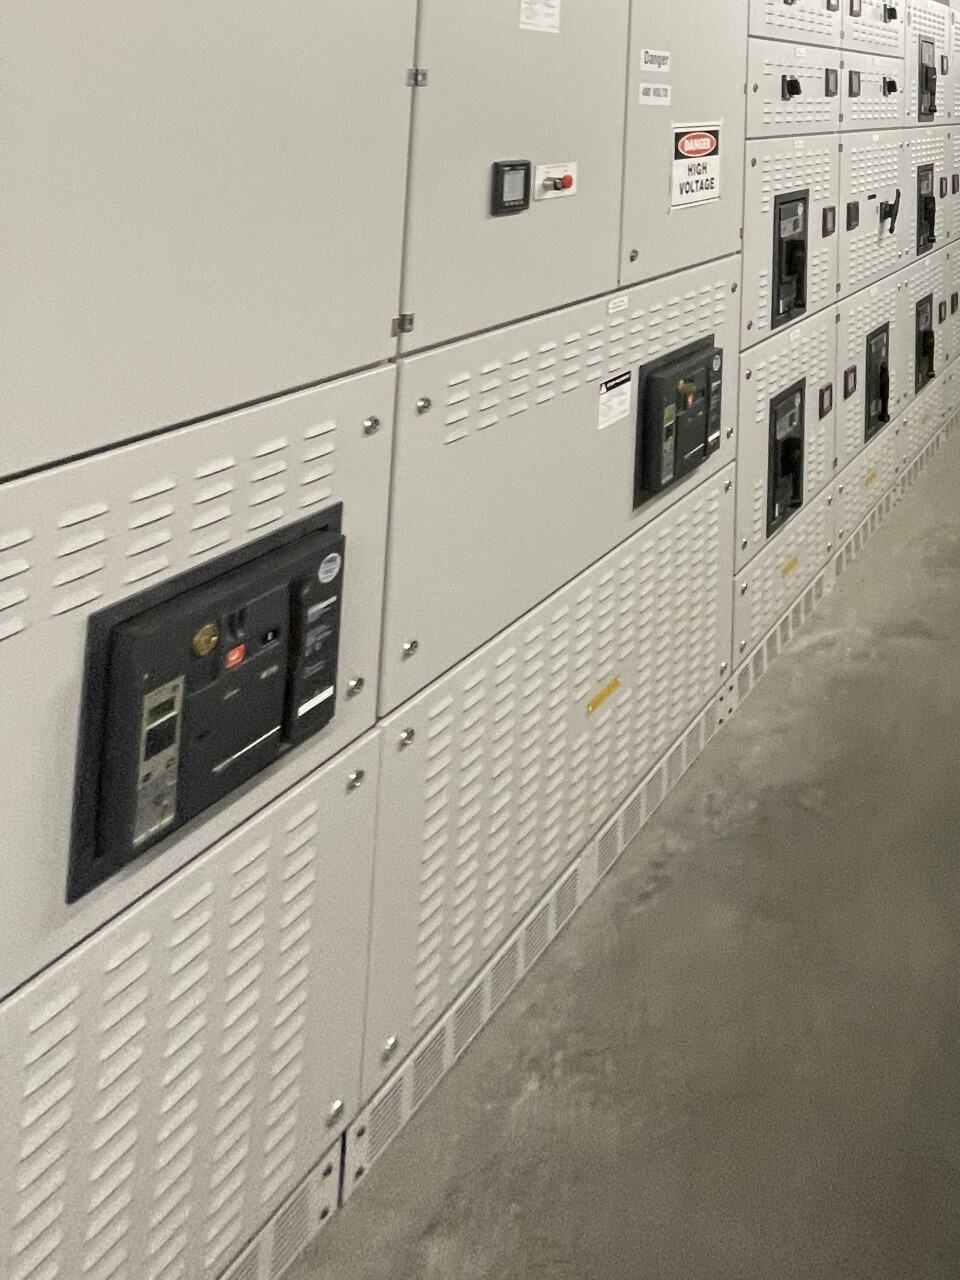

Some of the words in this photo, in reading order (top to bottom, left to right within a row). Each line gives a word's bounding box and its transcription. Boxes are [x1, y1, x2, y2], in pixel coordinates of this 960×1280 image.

[643, 50, 670, 69] Danger
[683, 137, 712, 152] DANGER
[687, 162, 708, 177] HIGH
[679, 177, 716, 196] VOLTAGE
